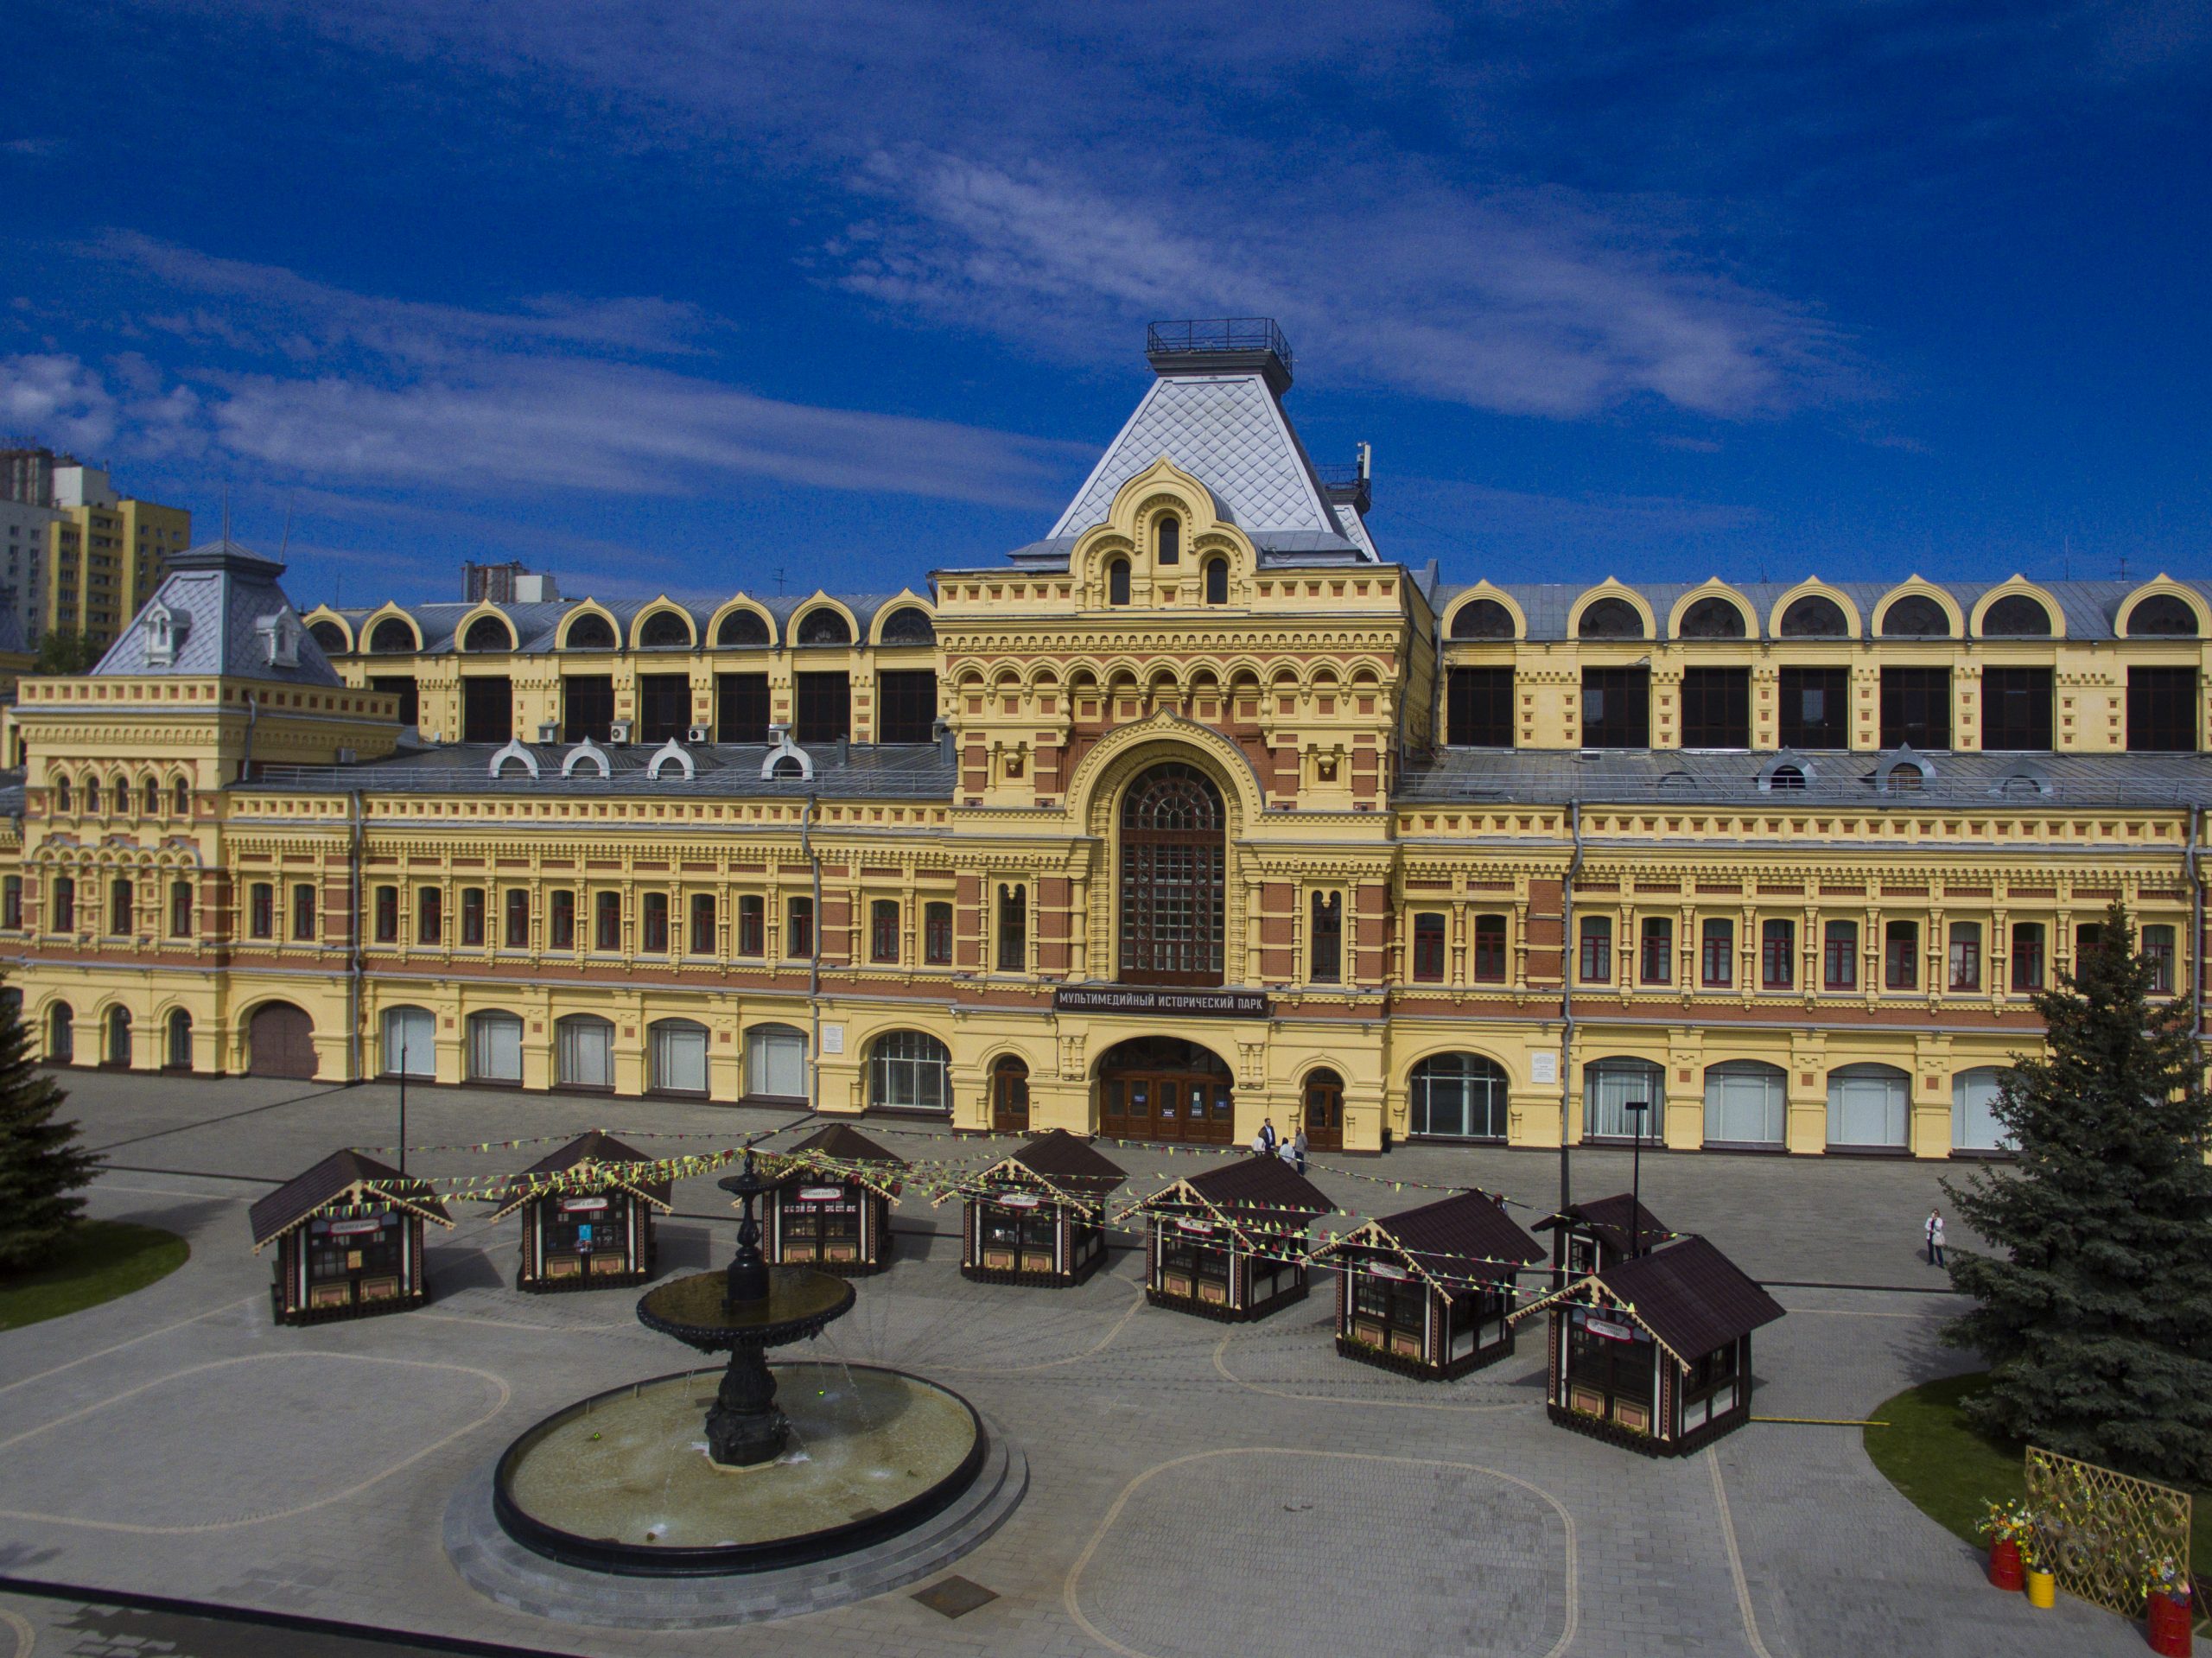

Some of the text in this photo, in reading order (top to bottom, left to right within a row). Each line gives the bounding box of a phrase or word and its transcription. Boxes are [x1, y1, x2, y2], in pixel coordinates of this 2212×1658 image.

[1059, 993, 1263, 1010] МУЛЬТИМЕДИЙНЫЙ ИСТОРИЧЕСКИЙ ПАРК
